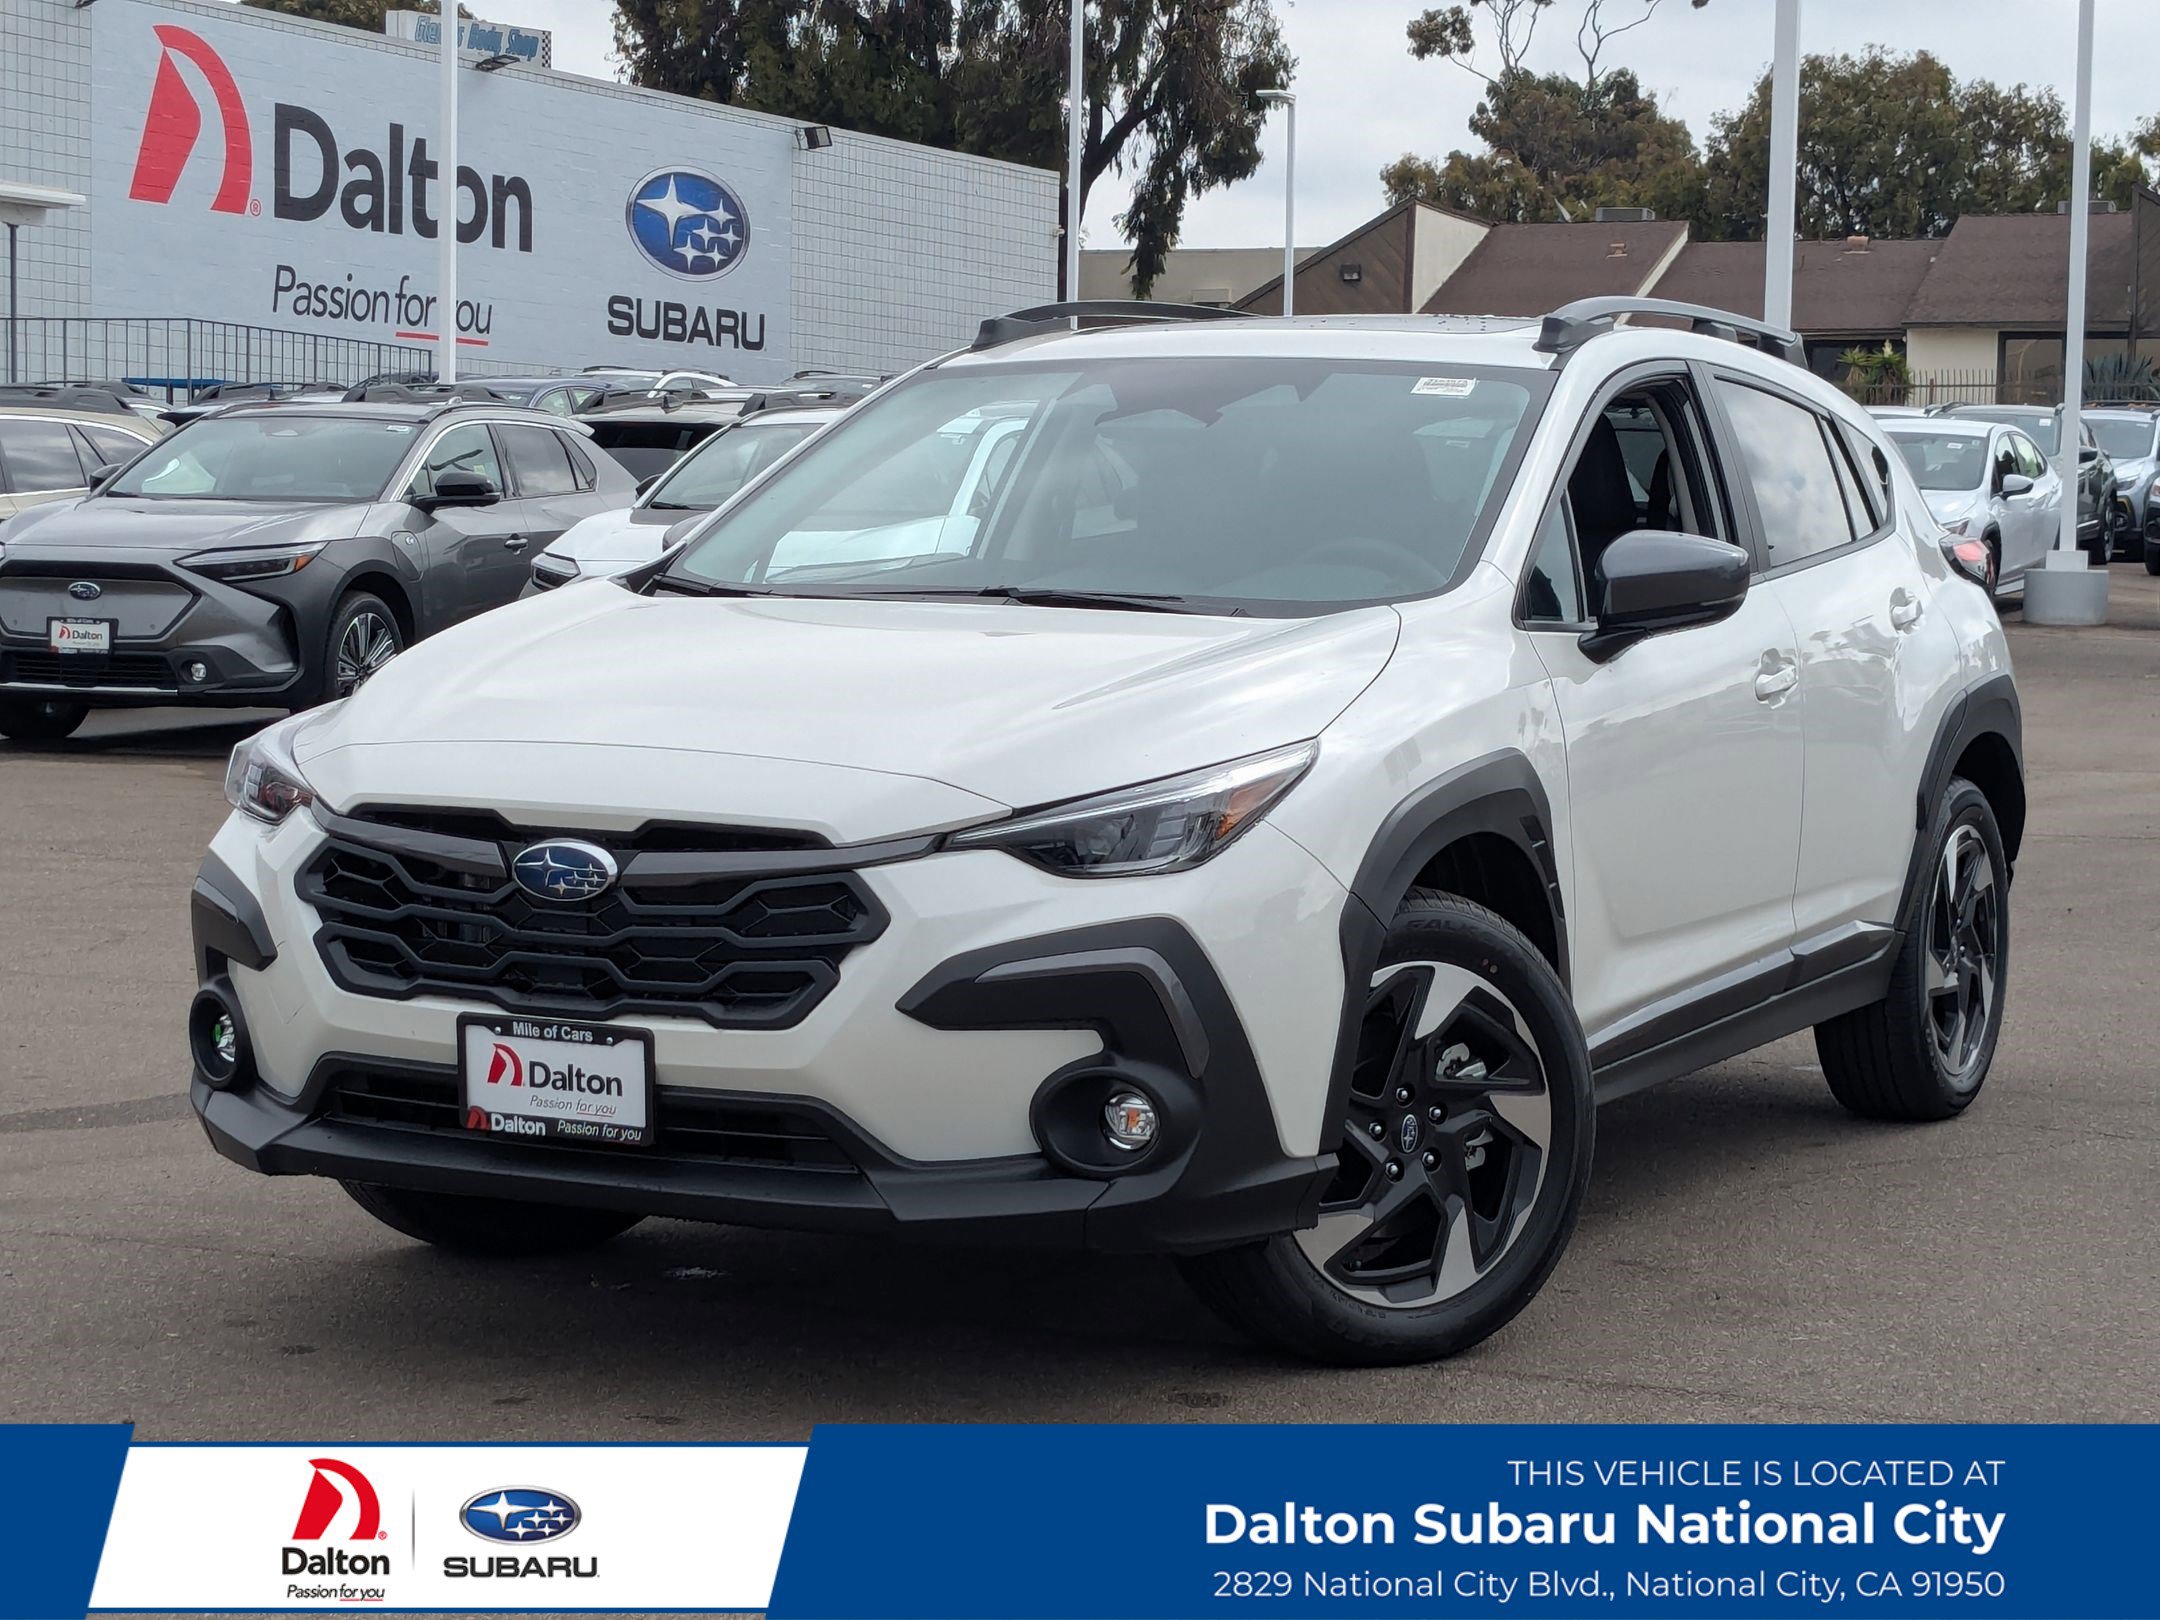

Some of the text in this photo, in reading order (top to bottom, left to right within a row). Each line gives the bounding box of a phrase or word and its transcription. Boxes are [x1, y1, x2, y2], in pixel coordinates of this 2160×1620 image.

[275, 102, 533, 253] Dalton
[272, 264, 493, 335] Passion for ou
[608, 295, 765, 351] SUBARU
[72, 629, 103, 640] Dalton
[512, 1021, 594, 1043] Mile of Cars
[528, 1060, 623, 1097] Dalton
[530, 1094, 617, 1116] Passion for you
[490, 1112, 643, 1141] Dalton Passion for you
